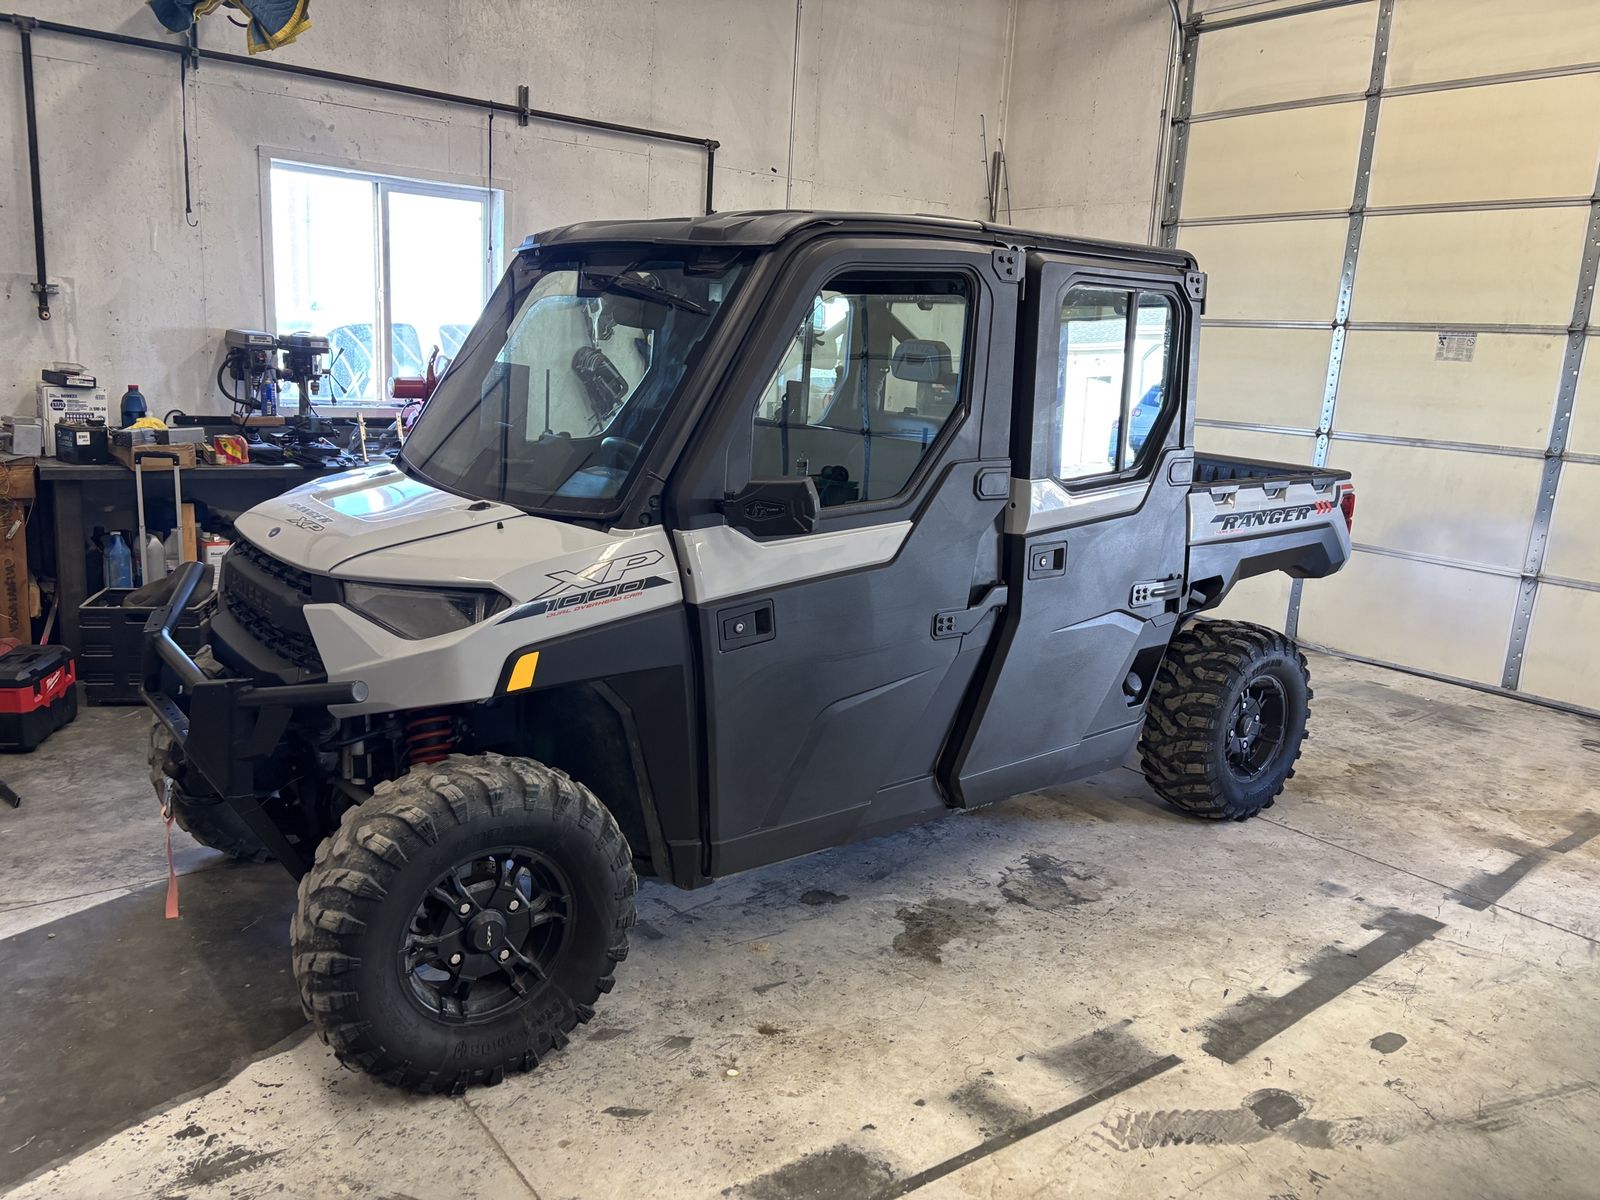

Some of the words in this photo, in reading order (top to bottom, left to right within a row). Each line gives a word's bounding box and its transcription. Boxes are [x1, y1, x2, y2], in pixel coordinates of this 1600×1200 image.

[286, 516, 325, 531] XP
[1221, 506, 1312, 531] RANGER
[527, 549, 665, 603] XP
[545, 578, 646, 612] 1000
[546, 609, 571, 618] DUAL
[573, 596, 622, 612] OVERHEAD
[623, 592, 643, 600] CAM
